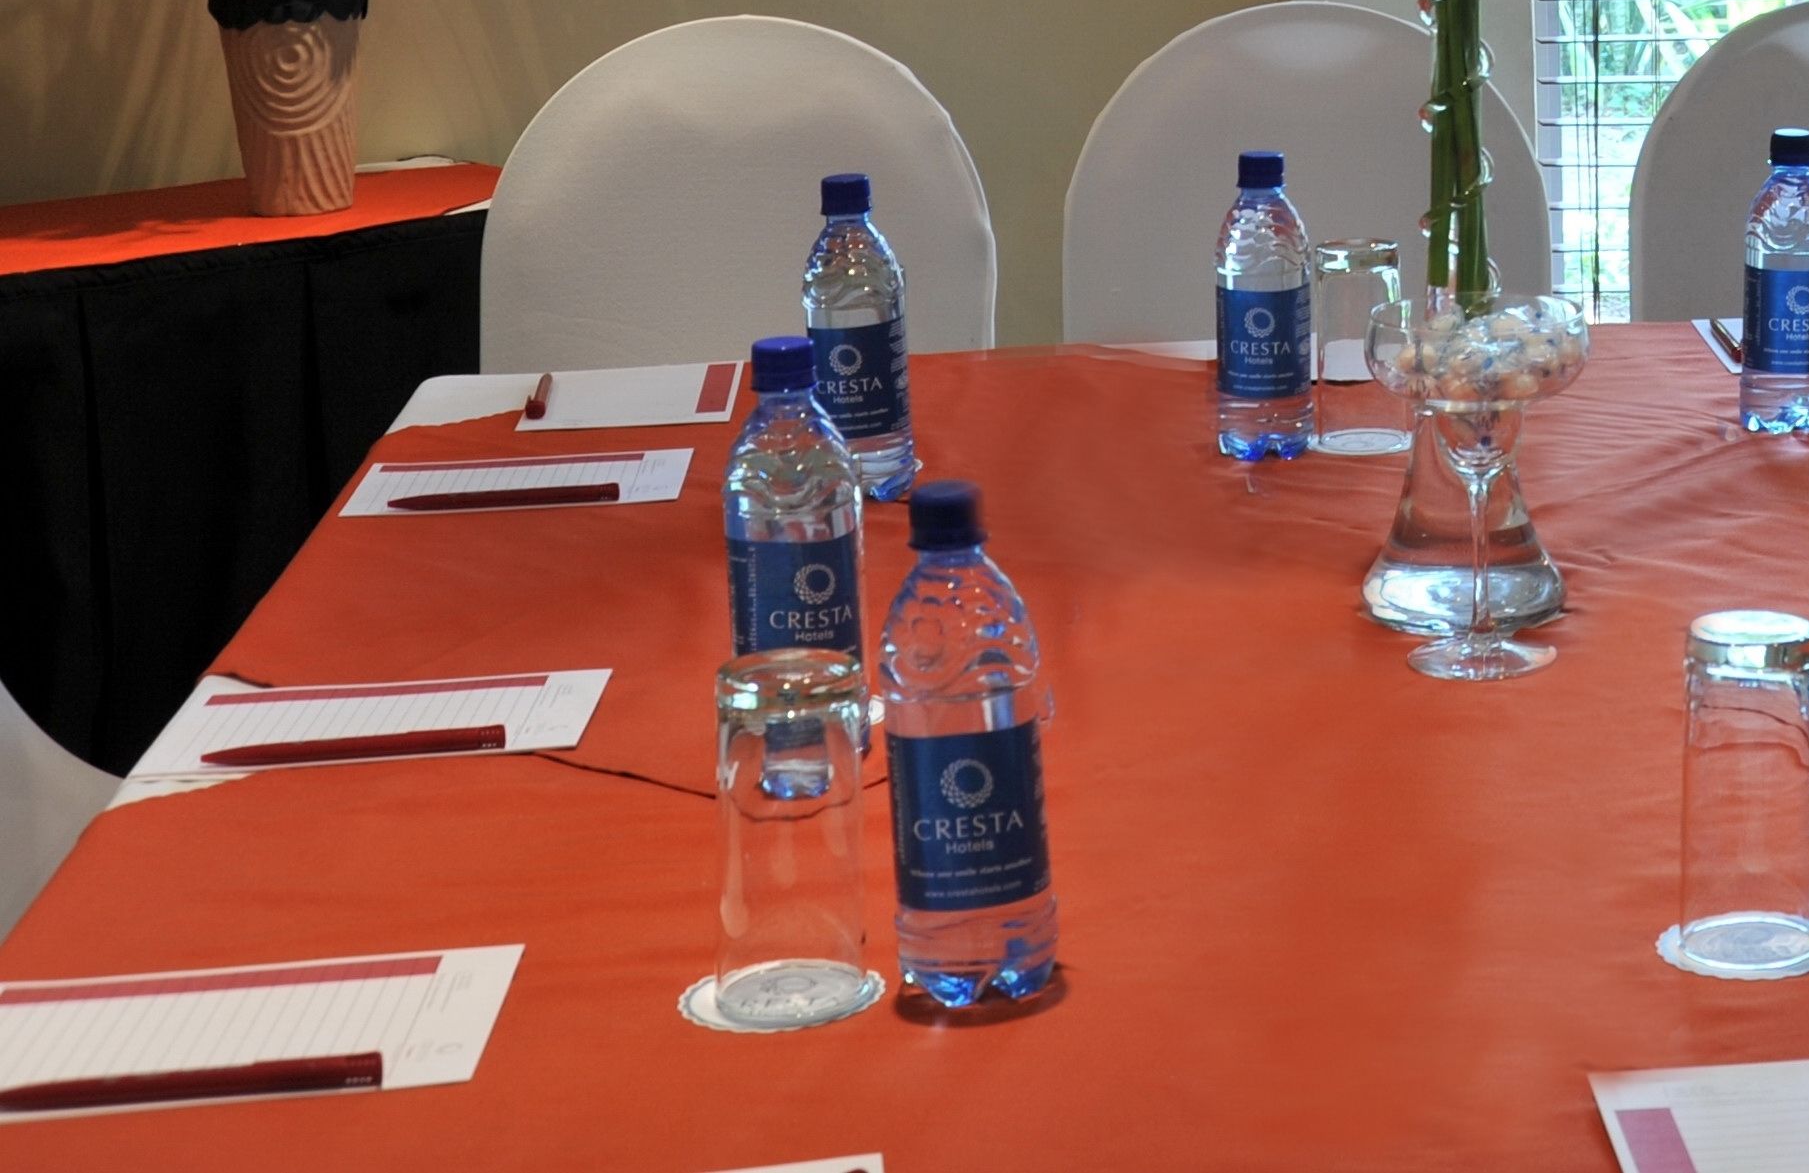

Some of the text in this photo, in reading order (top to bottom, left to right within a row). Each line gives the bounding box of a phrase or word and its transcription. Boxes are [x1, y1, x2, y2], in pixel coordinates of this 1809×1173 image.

[1230, 339, 1291, 356] CRESTA
[816, 376, 883, 395] CRESTA
[832, 394, 864, 405] Hotels
[769, 604, 853, 630] CRESTA
[794, 630, 835, 643] Hotels
[913, 809, 1025, 842] CRESTA
[945, 838, 995, 855] Hotels
